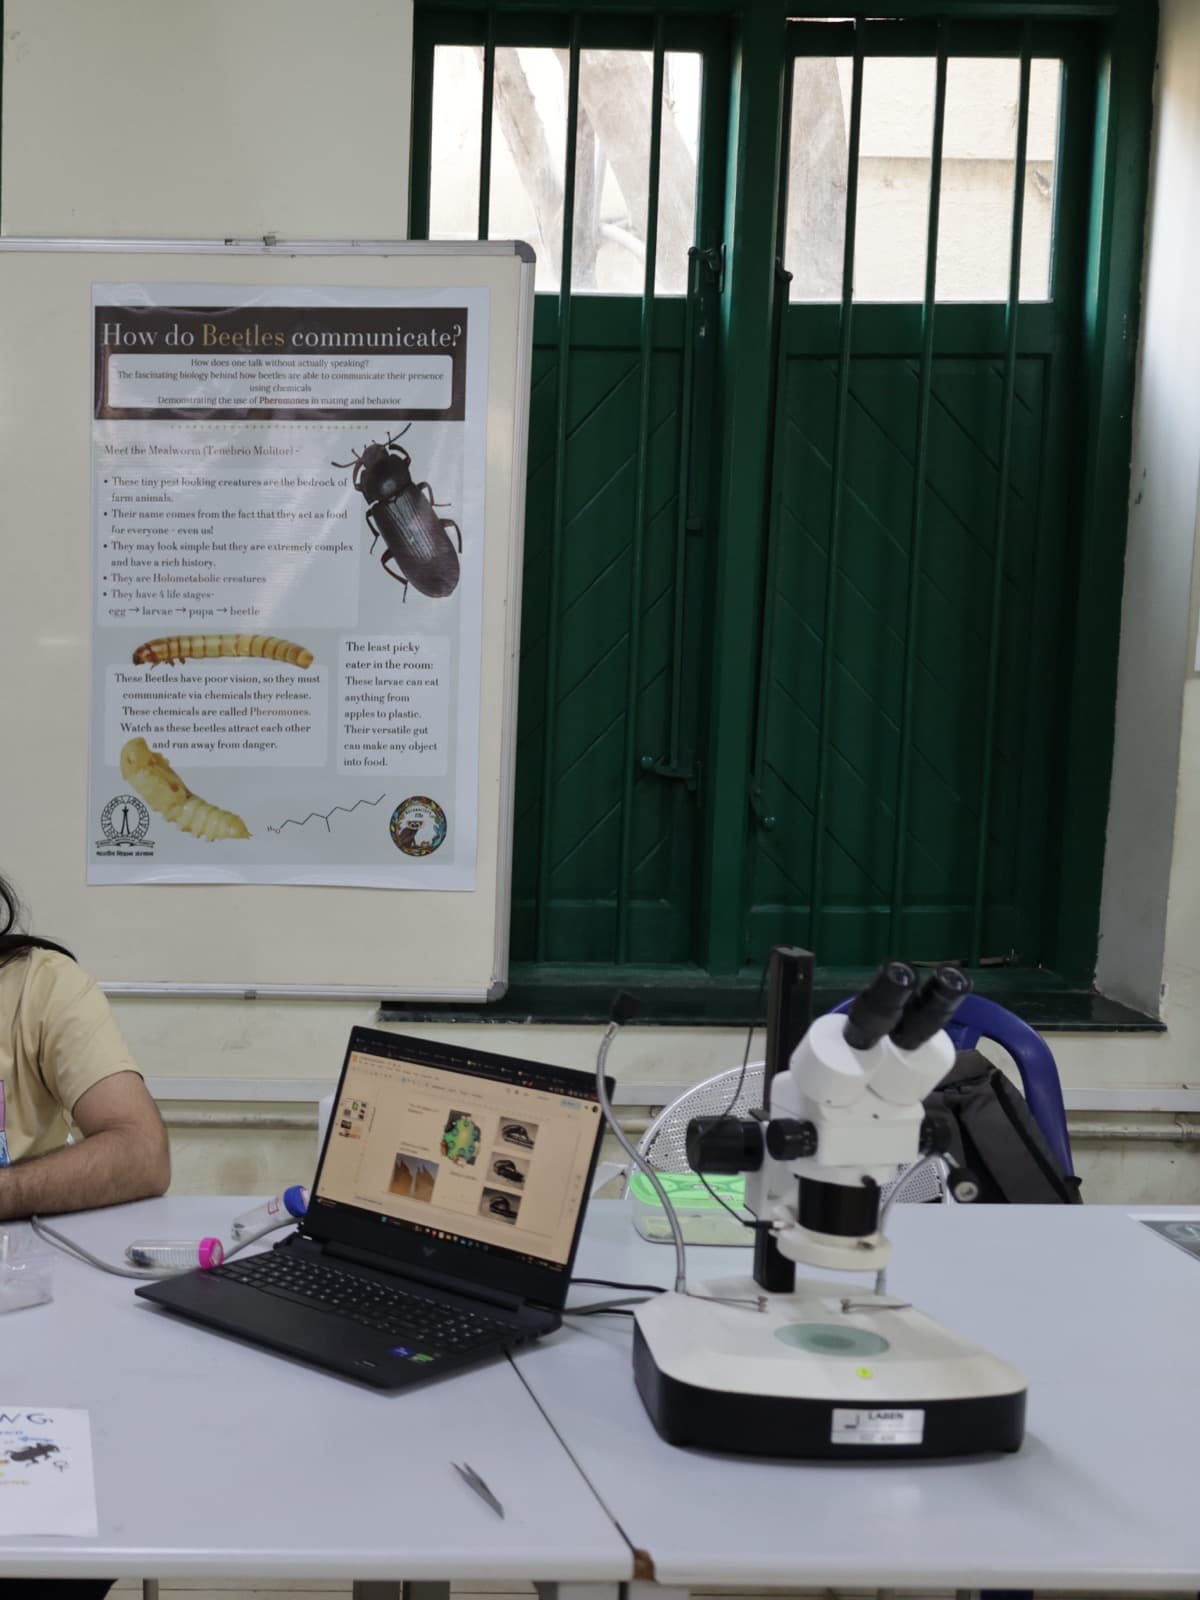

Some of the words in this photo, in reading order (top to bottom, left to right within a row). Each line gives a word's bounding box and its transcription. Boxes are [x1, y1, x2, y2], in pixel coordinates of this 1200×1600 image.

[103, 323, 157, 346] How
[164, 323, 194, 345] do
[202, 323, 284, 347] Beetles
[291, 324, 461, 347] communicate?
[191, 358, 208, 366] How
[210, 358, 229, 366] does
[248, 359, 262, 367] talk
[264, 359, 295, 367] without
[297, 359, 328, 369] actually
[330, 359, 369, 369] speaking?
[104, 445, 128, 455] Meet
[130, 445, 146, 454] the
[148, 444, 200, 455] Mealworm
[202, 445, 250, 456] (Tenebrio
[253, 445, 293, 455] Molitor)
[111, 508, 136, 517] Their
[197, 509, 219, 518] from
[221, 509, 236, 518] the
[238, 509, 254, 518] fact
[256, 509, 274, 518] that
[276, 509, 296, 521] they
[298, 511, 312, 519] act
[326, 509, 347, 519] food
[111, 541, 132, 552] They
[136, 544, 154, 553] may
[157, 541, 177, 550] look
[180, 541, 209, 553] simple
[212, 541, 226, 550] but
[229, 541, 248, 553] they
[267, 542, 312, 553] extremely
[315, 542, 353, 553] complex
[110, 557, 128, 566] and
[130, 557, 152, 566] have
[161, 557, 179, 566] rich
[181, 557, 216, 569] history.
[110, 573, 132, 584] They
[153, 573, 220, 582] Holometabolic
[108, 607, 126, 617] egg
[141, 606, 173, 616] larvae
[188, 607, 214, 617] pupa
[229, 606, 261, 616] beetle
[346, 641, 364, 651] The
[368, 641, 389, 651] least
[393, 641, 418, 655] picky
[385, 659, 400, 669] the
[116, 673, 141, 682] These
[145, 673, 177, 682] Beetles
[180, 673, 201, 682] have
[204, 676, 226, 686] poor
[230, 675, 260, 683] vision,
[276, 674, 293, 685] they
[298, 675, 319, 683] must
[344, 675, 372, 685] These
[374, 676, 404, 685] larvae
[122, 690, 186, 699] communicate
[204, 690, 251, 699] chemicals
[253, 690, 273, 702] they
[275, 690, 311, 699] release.
[344, 692, 384, 704] anything
[387, 692, 409, 701] from
[122, 706, 149, 715] These
[152, 706, 199, 715] chemicals
[219, 706, 247, 716] called
[250, 706, 311, 716] Pheromones.
[344, 708, 374, 720] apples
[388, 709, 421, 720] plastic.
[120, 722, 151, 732] Watch
[166, 722, 190, 732] these
[193, 723, 226, 732] beetles
[228, 724, 258, 732] attract
[260, 723, 282, 732] each
[284, 723, 311, 732] other
[346, 724, 369, 734] Their
[372, 725, 410, 734] versatile
[413, 726, 428, 737] gut
[152, 739, 170, 749] and
[190, 743, 215, 751] away
[217, 740, 240, 748] from
[242, 740, 278, 750] danger.
[362, 740, 387, 749] make
[390, 744, 405, 752] any
[408, 741, 436, 753] object
[344, 758, 361, 766] into
[364, 756, 387, 766] food.
